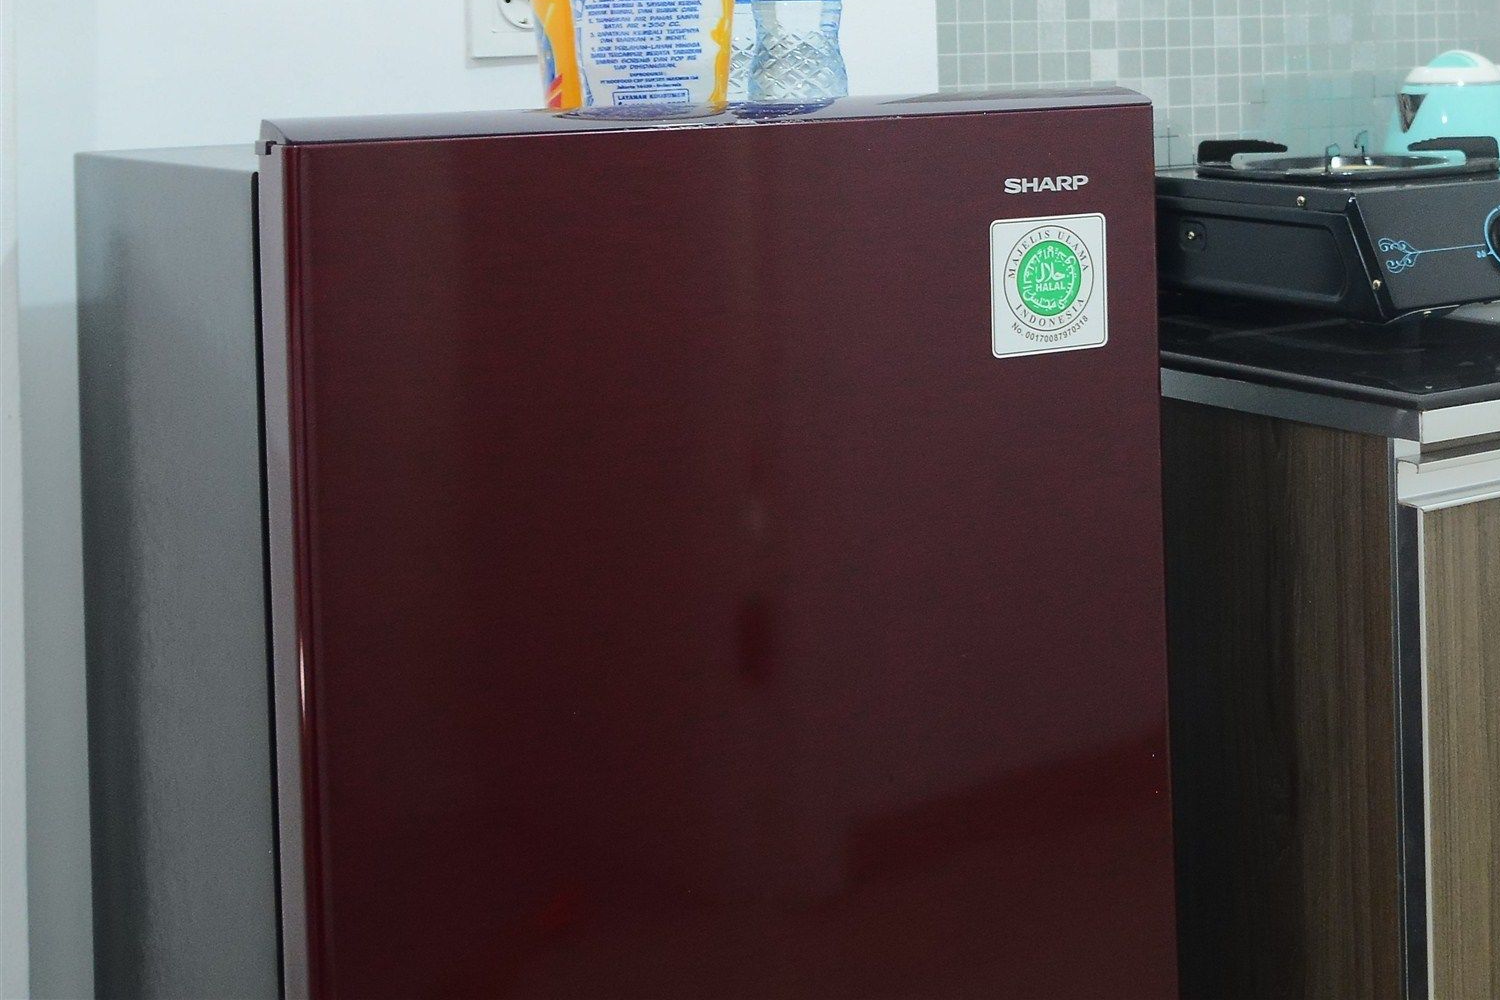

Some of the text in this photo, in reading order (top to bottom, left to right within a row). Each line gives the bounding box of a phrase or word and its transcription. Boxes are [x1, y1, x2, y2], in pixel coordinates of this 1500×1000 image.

[1004, 175, 1089, 194] SHARP
[1008, 230, 1089, 278] MAJELIS ULAMA
[1036, 282, 1066, 292] HALAL
[1016, 298, 1084, 327] INDONESIA
[1012, 322, 1023, 336] No.
